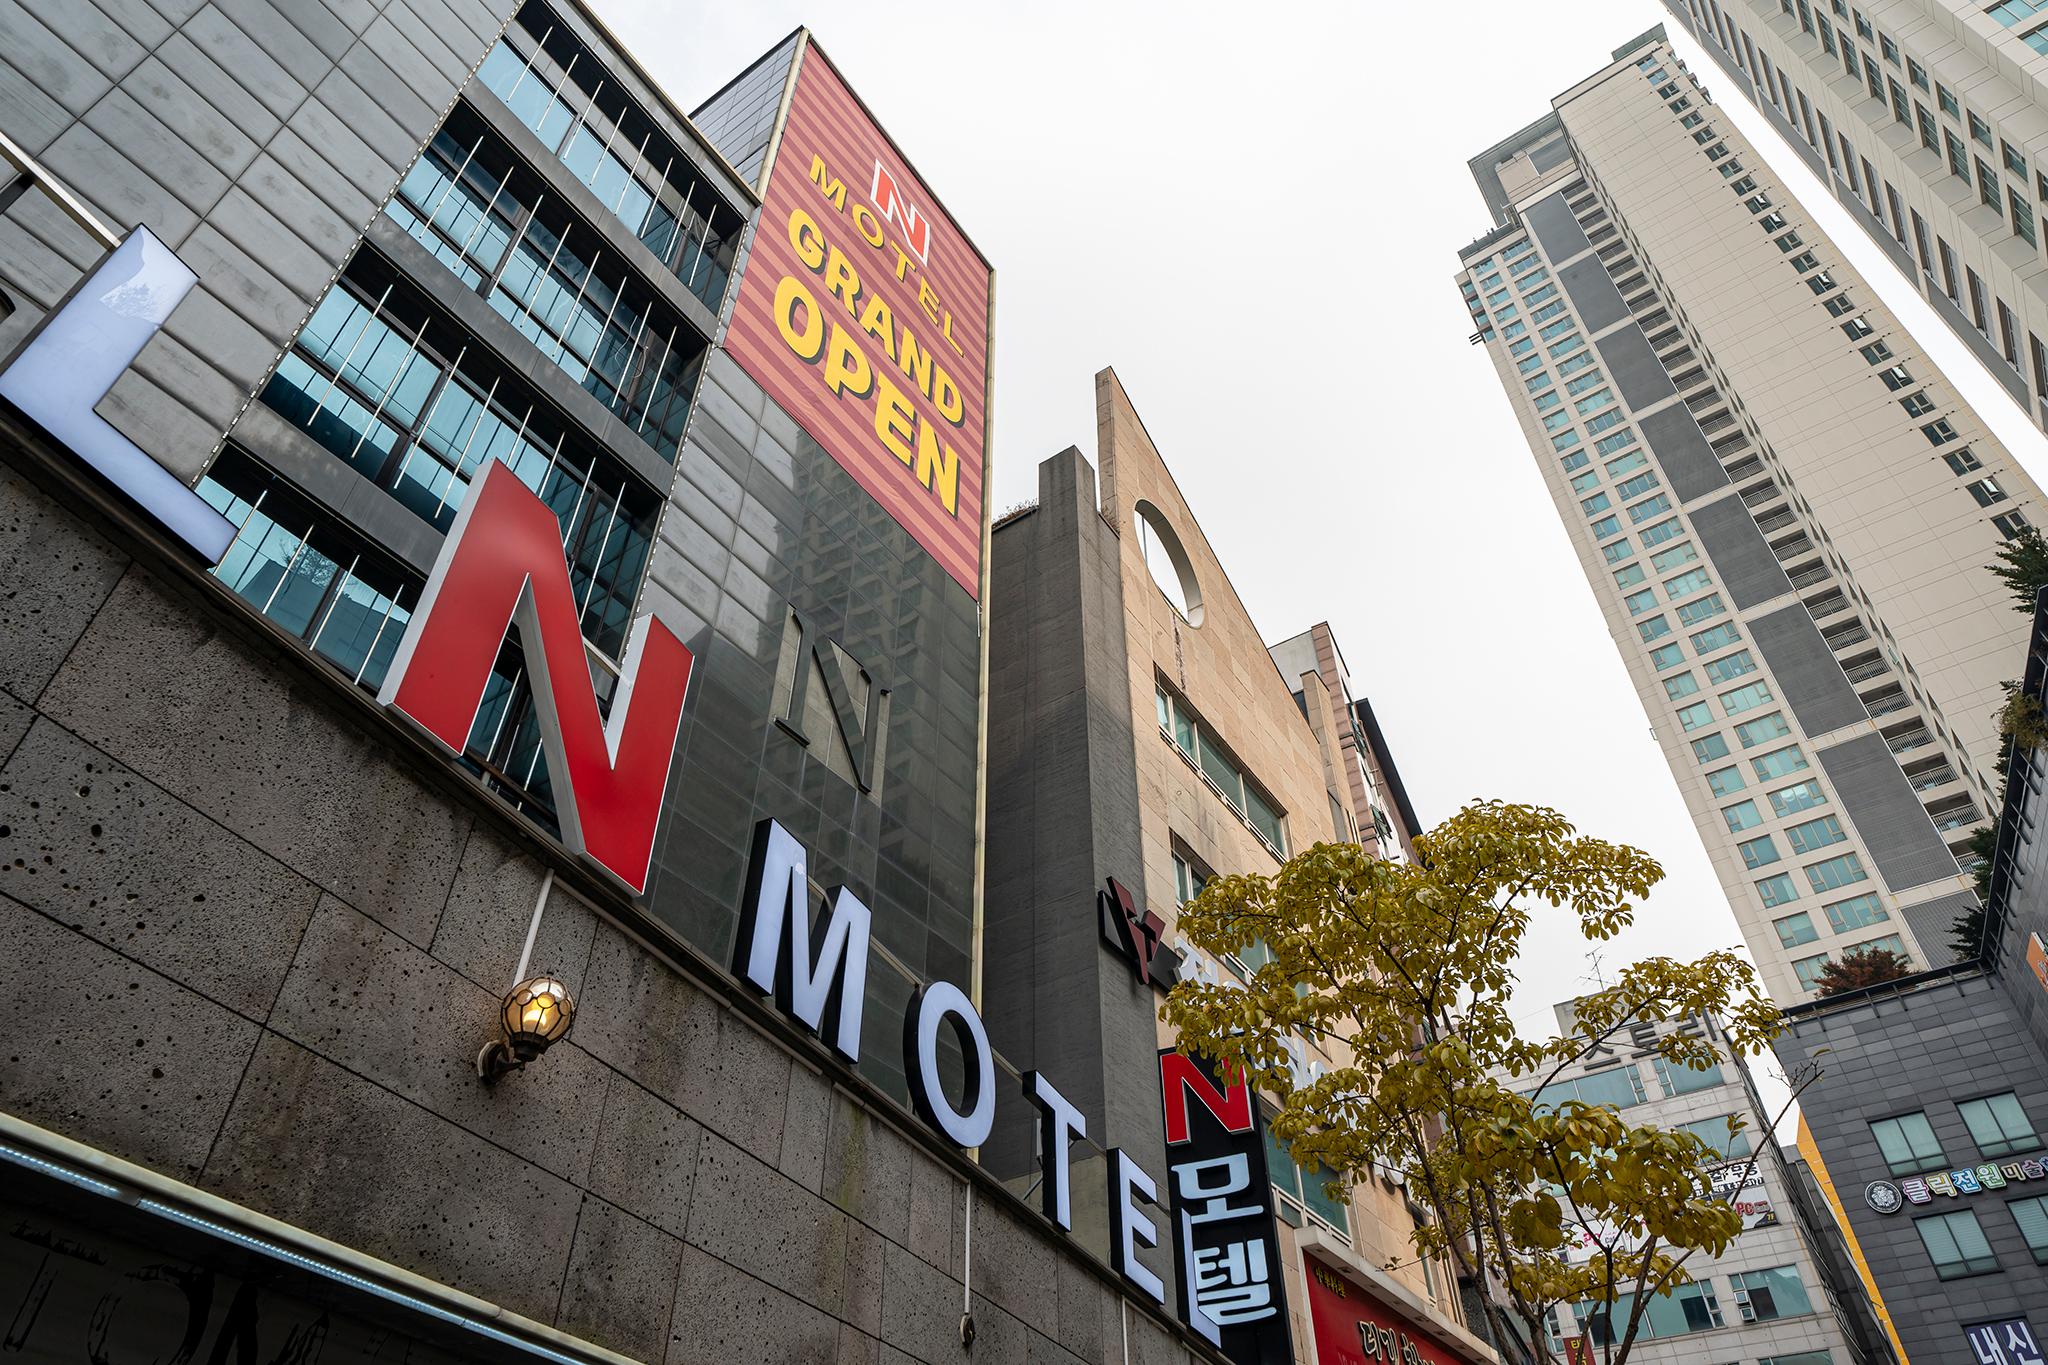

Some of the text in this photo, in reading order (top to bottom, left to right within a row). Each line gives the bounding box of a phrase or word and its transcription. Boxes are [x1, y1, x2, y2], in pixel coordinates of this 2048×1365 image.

[809, 153, 966, 358] MOTEL
[870, 158, 931, 267] N
[773, 274, 961, 518] OPEN
[787, 208, 966, 429] GRAND
[378, 457, 1221, 1348] N MOTEL
[1159, 1052, 1254, 1145] N
[1170, 1152, 1277, 1326] 모텔
[1969, 1321, 2043, 1365] 내신
